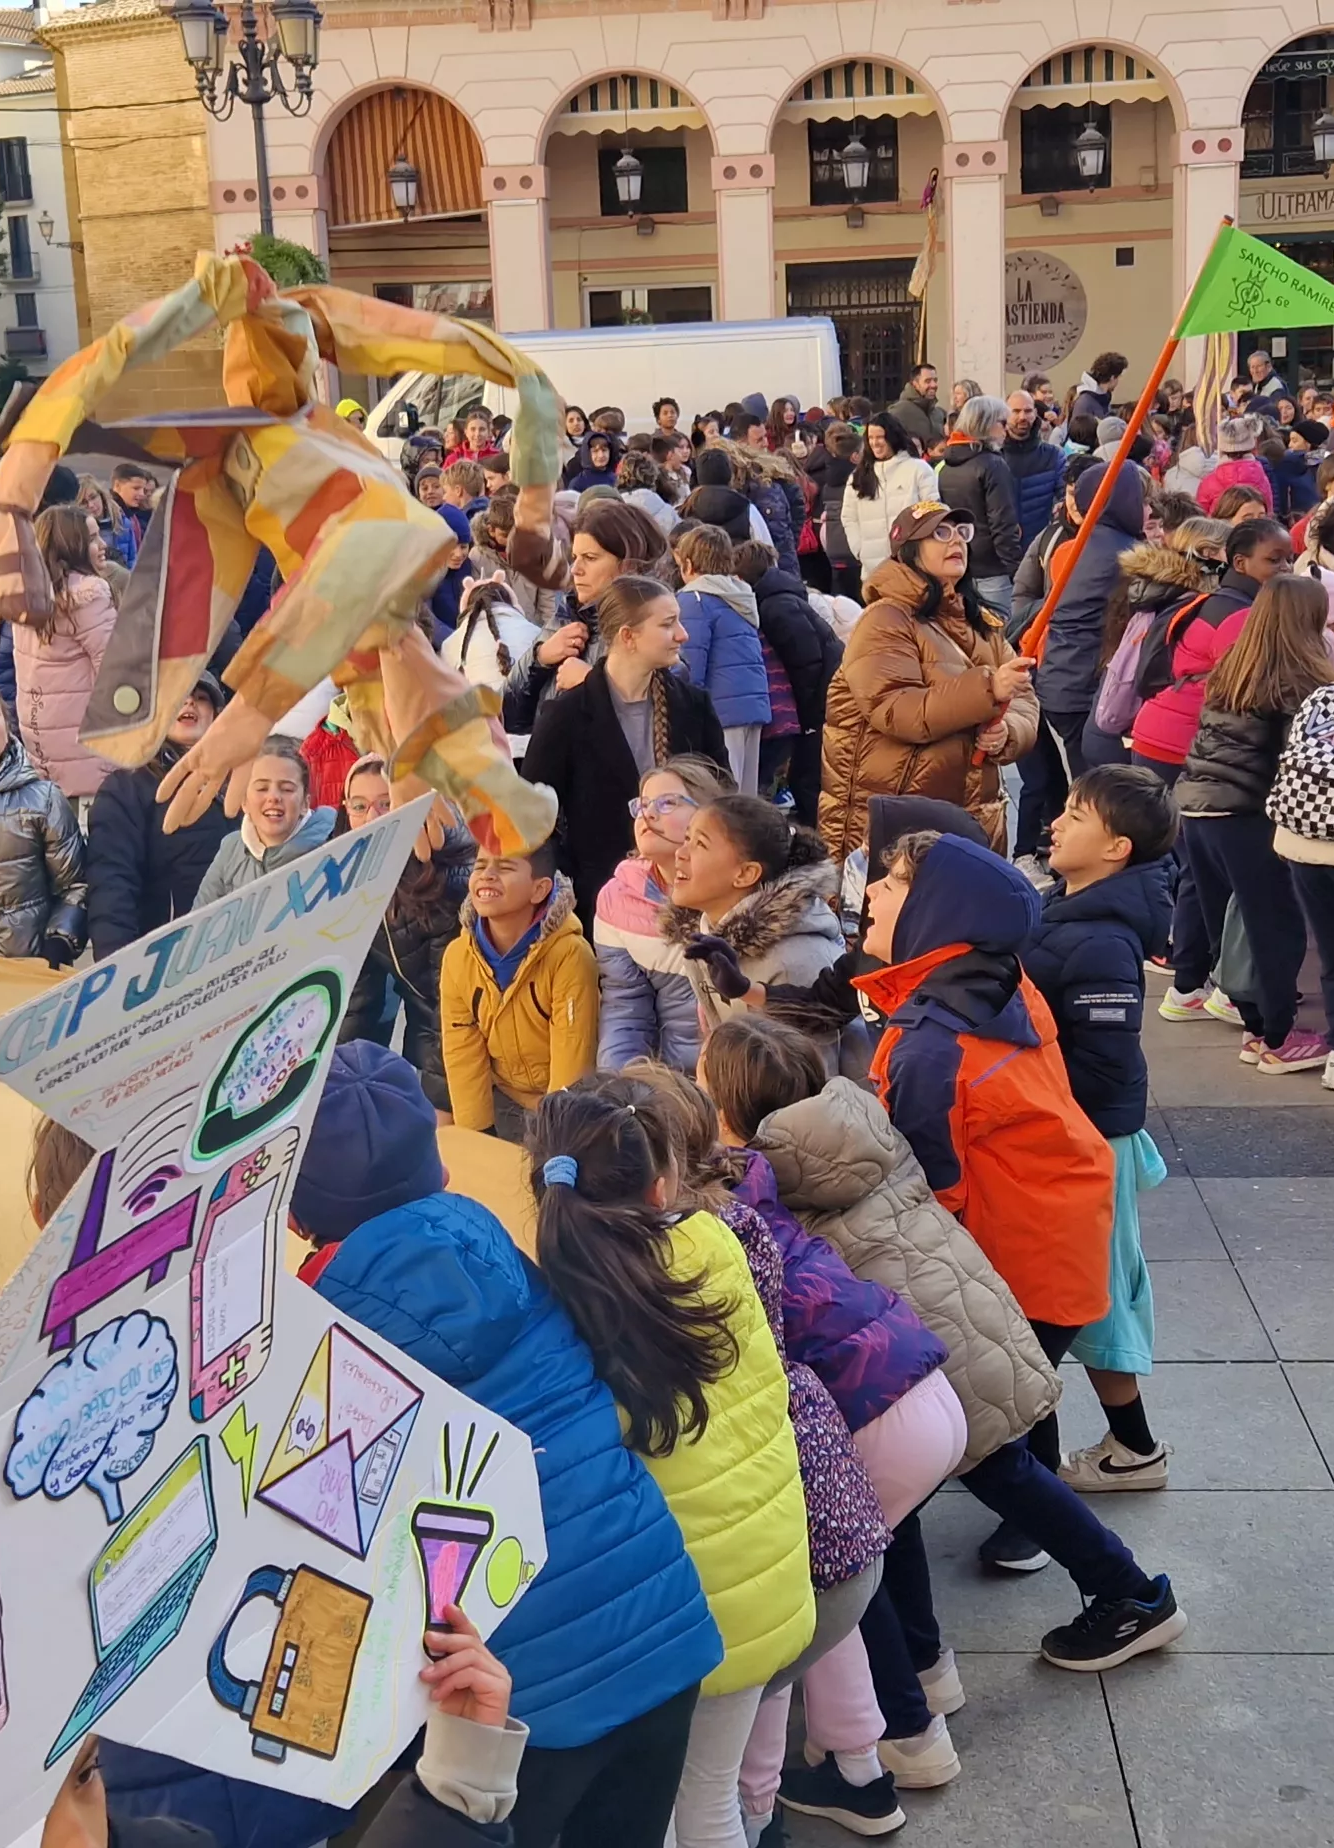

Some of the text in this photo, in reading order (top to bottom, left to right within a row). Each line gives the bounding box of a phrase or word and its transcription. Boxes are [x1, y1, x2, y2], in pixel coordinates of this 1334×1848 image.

[1295, 60, 1313, 71] sus
[1238, 247, 1289, 284] SANCHO
[1017, 277, 1034, 302] LA
[1005, 301, 1066, 326] ASTIENDA
[123, 886, 271, 1011] JUAN
